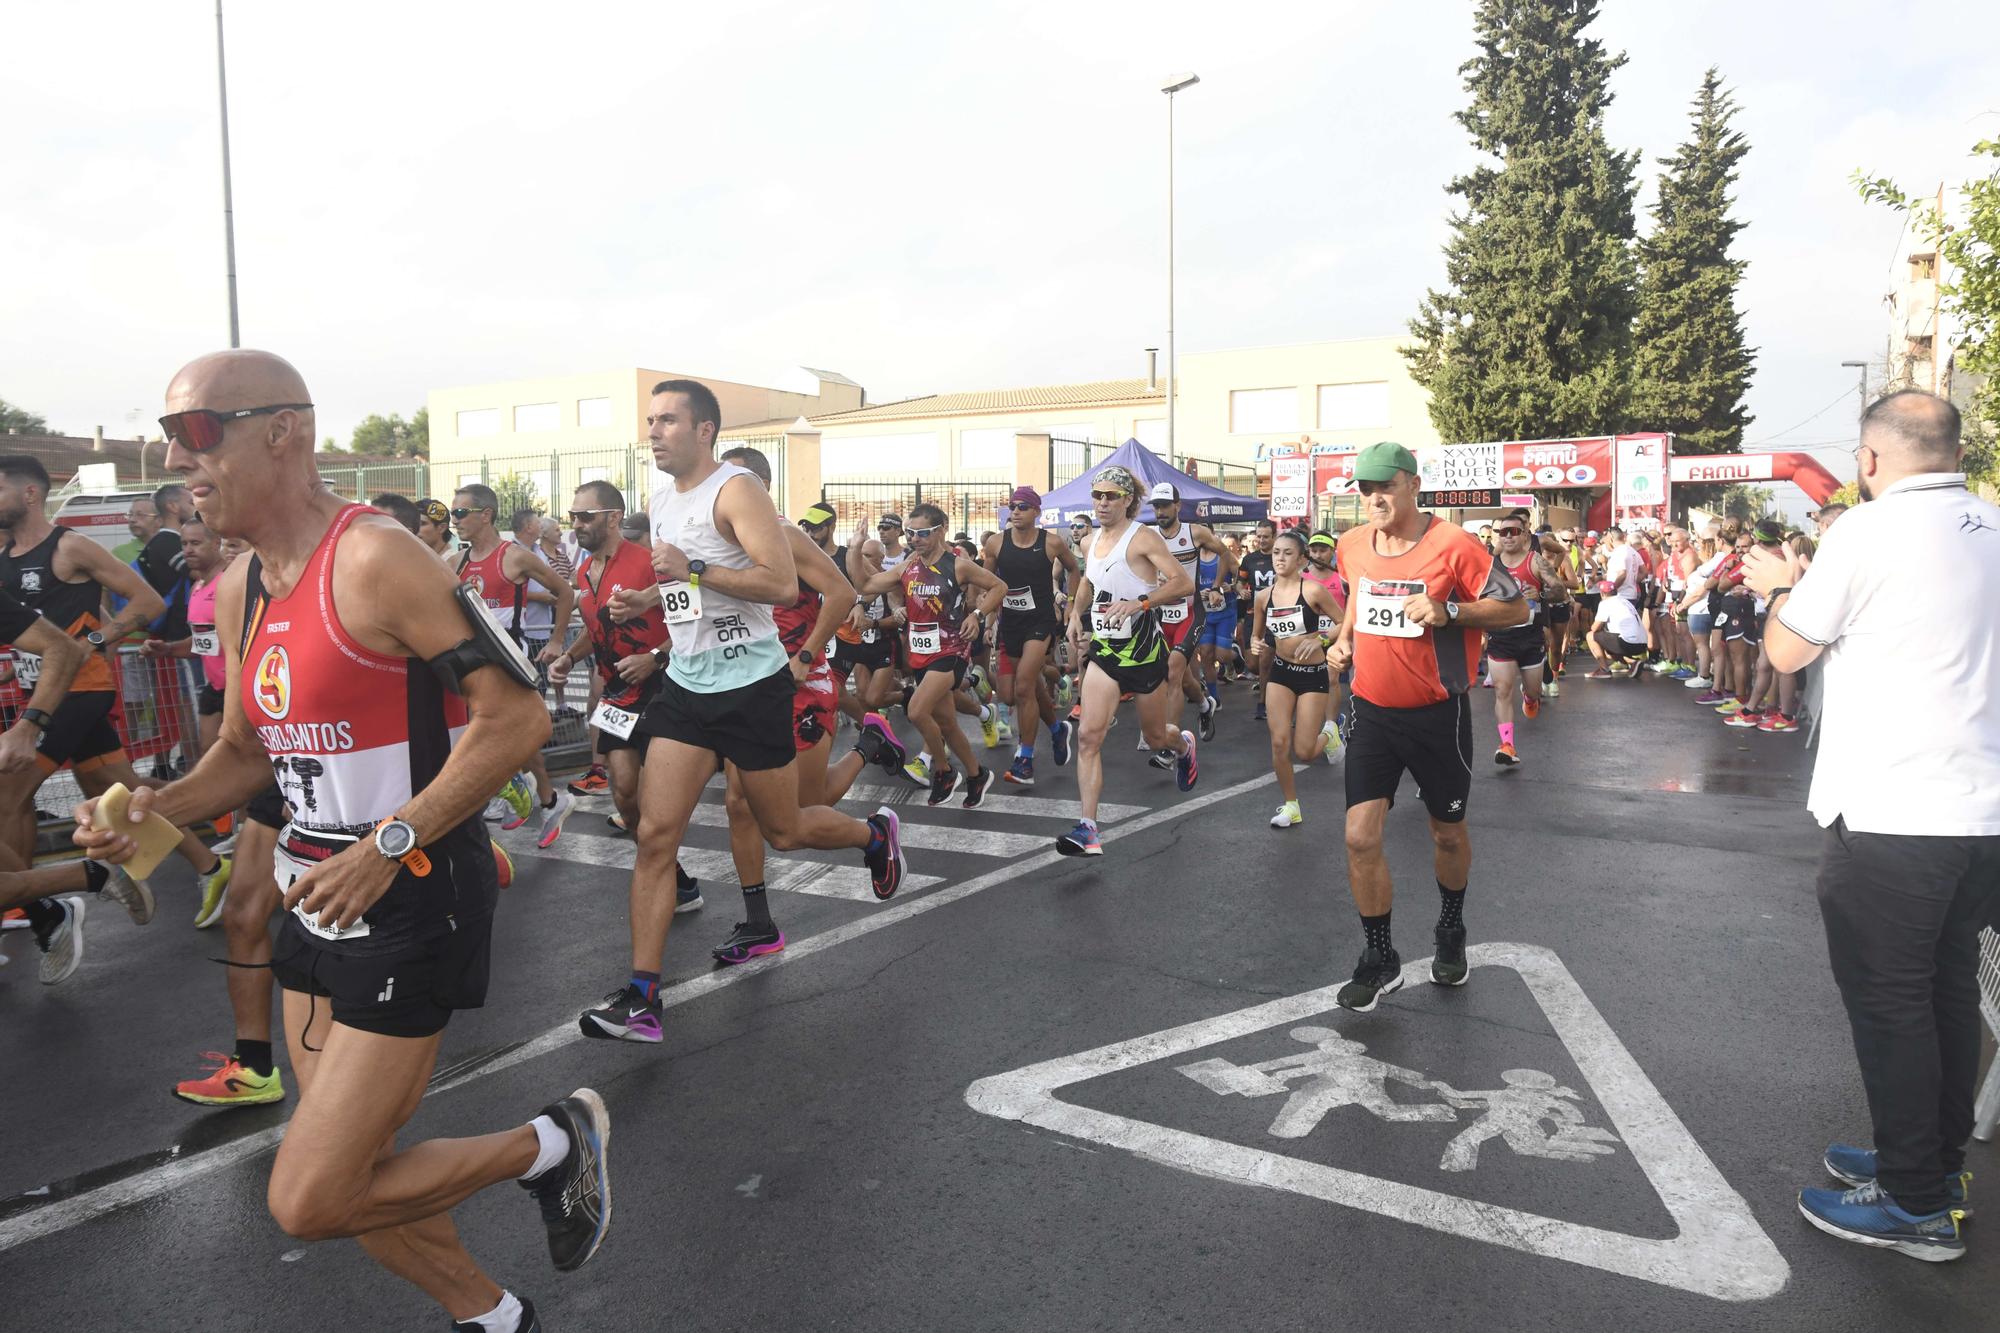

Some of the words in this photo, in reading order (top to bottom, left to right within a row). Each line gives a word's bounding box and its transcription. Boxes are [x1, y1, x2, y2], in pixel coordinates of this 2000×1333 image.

[1444, 446, 1497, 458] XXVIII
[1523, 448, 1577, 467] FAMU
[1445, 467, 1497, 478] DUER
[1689, 465, 1750, 480] FAMU
[1367, 607, 1405, 629] 291
[1271, 621, 1296, 634] 389
[1287, 664, 1316, 674] NIKE
[601, 706, 630, 729] 482
